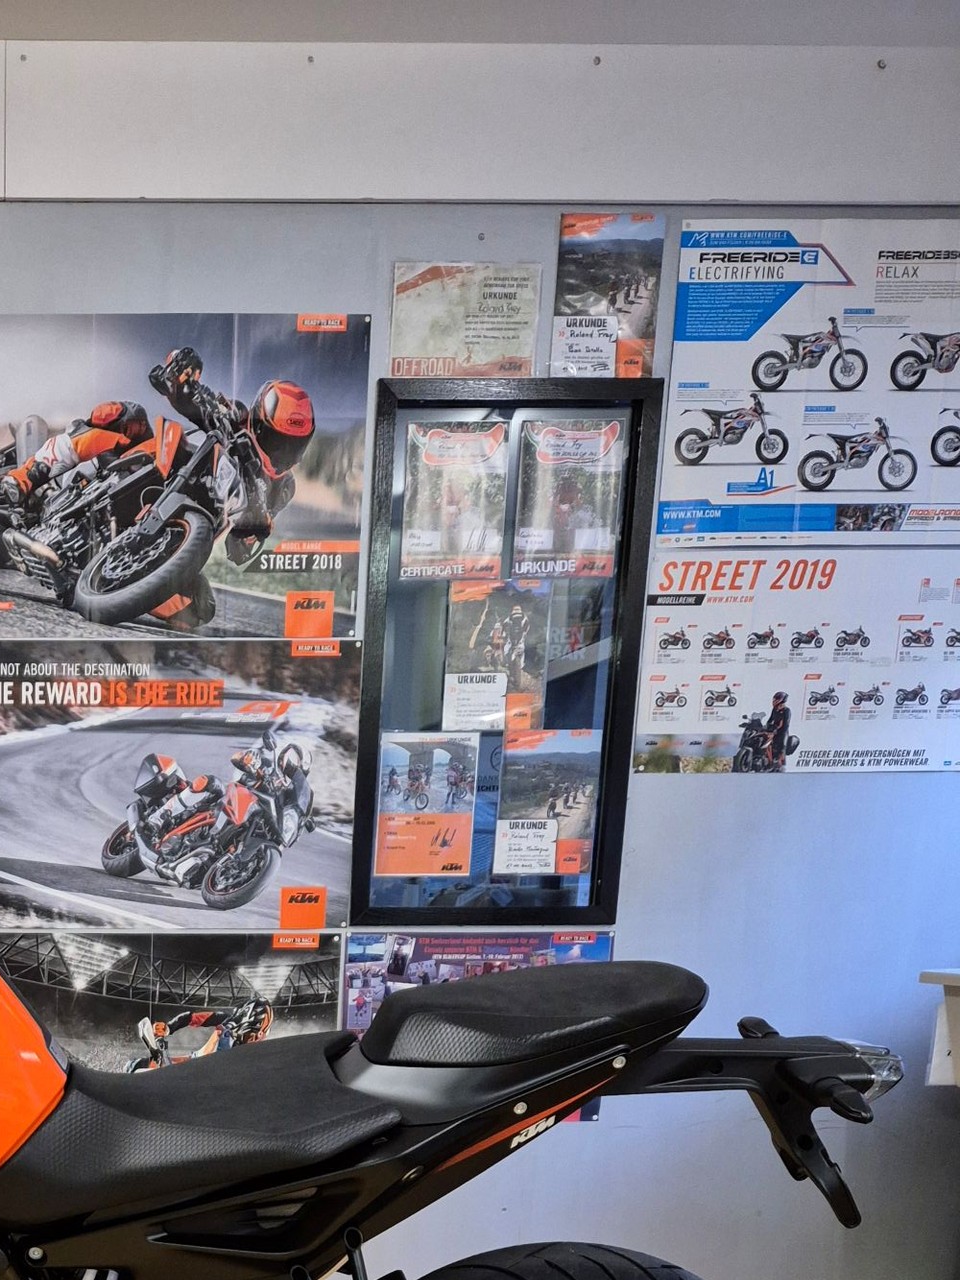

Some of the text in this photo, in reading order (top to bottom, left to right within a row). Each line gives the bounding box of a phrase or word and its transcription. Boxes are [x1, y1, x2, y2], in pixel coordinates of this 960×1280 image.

[699, 252, 800, 263] FREERIDE
[689, 266, 784, 280] ELECTRIFYING
[876, 266, 919, 278] RELAX
[483, 292, 518, 300] URKUNDE
[566, 318, 607, 328] URKUNDE
[394, 358, 453, 376] OFFROAD
[663, 509, 721, 519] WWW.KTM.COM
[260, 554, 342, 570] STREET 2018
[515, 560, 576, 574] URKUNDE
[401, 564, 465, 577] CERTIFICATE
[658, 559, 837, 592] STREET 2019
[294, 597, 326, 609] KTM
[706, 596, 755, 604] WWW.KTM.COM
[0, 663, 21, 676] NOT
[24, 663, 58, 676] ABOUT
[62, 663, 80, 676] THE
[84, 663, 150, 677] DESTINATION
[457, 675, 497, 684] URKUNDE
[21, 682, 102, 705] REWARD
[109, 683, 128, 705] IS
[135, 682, 169, 705] THE
[176, 682, 220, 705] RIDE
[799, 748, 926, 758] STEIGERE DEIN FAHRVERGNÜGEN MIT
[796, 759, 810, 767] KTM
[812, 759, 858, 767] POWERPARTS
[867, 758, 882, 766] KTM
[509, 821, 548, 830] URKUNDE
[441, 863, 463, 871] KTM
[288, 892, 320, 903] KTM
